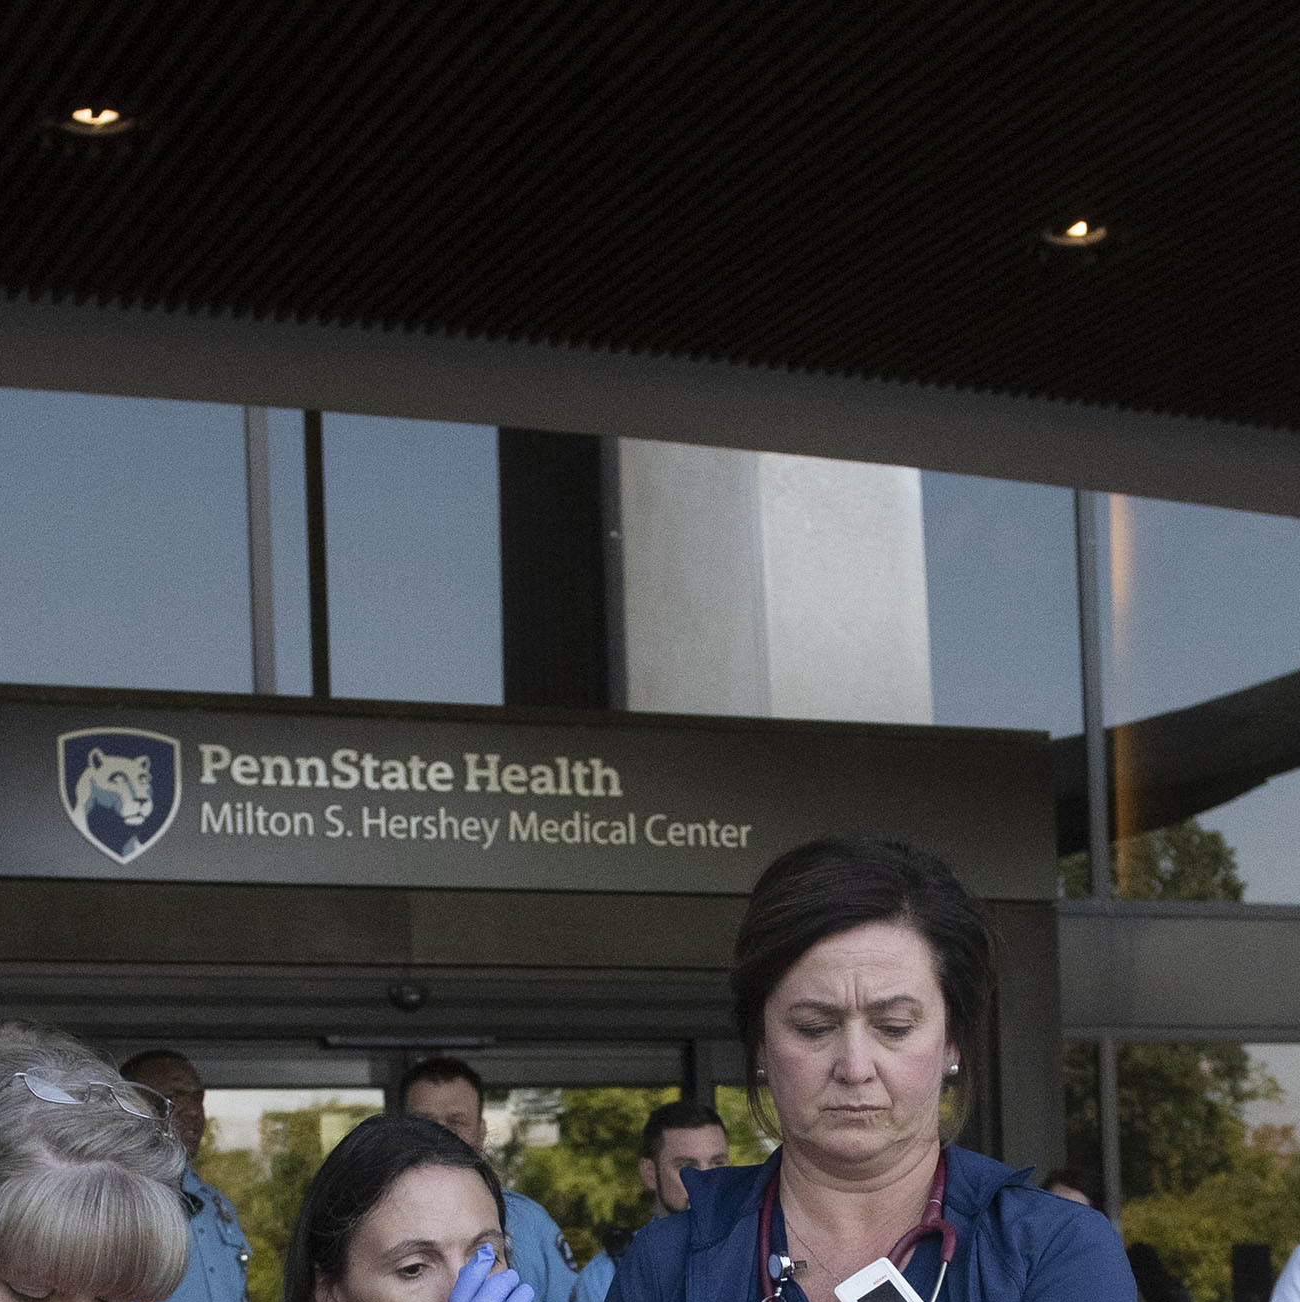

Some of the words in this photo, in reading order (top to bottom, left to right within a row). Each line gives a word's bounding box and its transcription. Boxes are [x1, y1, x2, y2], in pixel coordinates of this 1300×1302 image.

[199, 743, 454, 792] PennState
[462, 752, 623, 797] Health
[200, 802, 314, 838] Milton
[323, 804, 353, 839] S.
[362, 807, 499, 850] Hershey
[508, 811, 636, 846] Medical
[643, 813, 752, 849] Center
